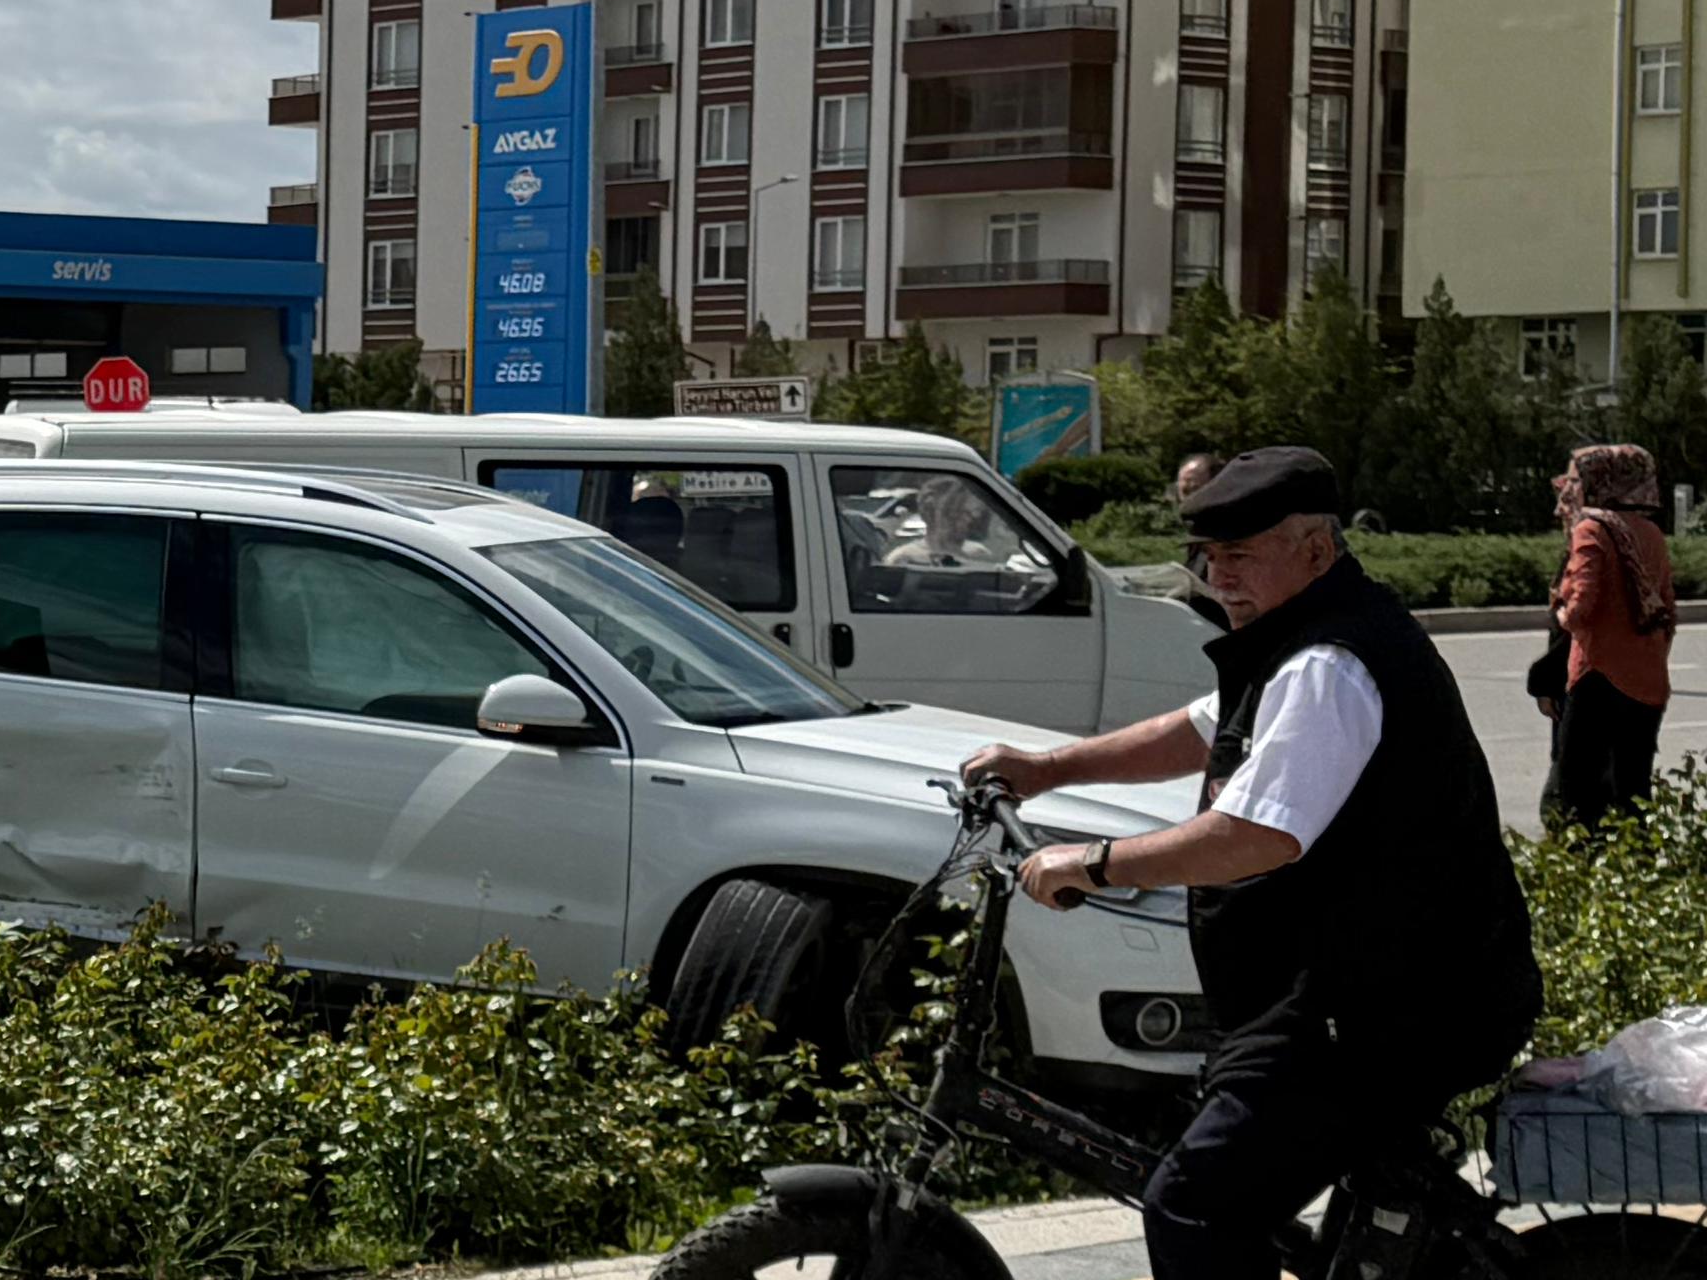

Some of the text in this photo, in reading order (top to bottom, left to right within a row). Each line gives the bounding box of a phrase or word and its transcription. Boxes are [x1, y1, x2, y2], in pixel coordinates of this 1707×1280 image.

[493, 127, 557, 154] AYGAZ
[52, 258, 112, 281] servis
[90, 377, 143, 404] DUR
